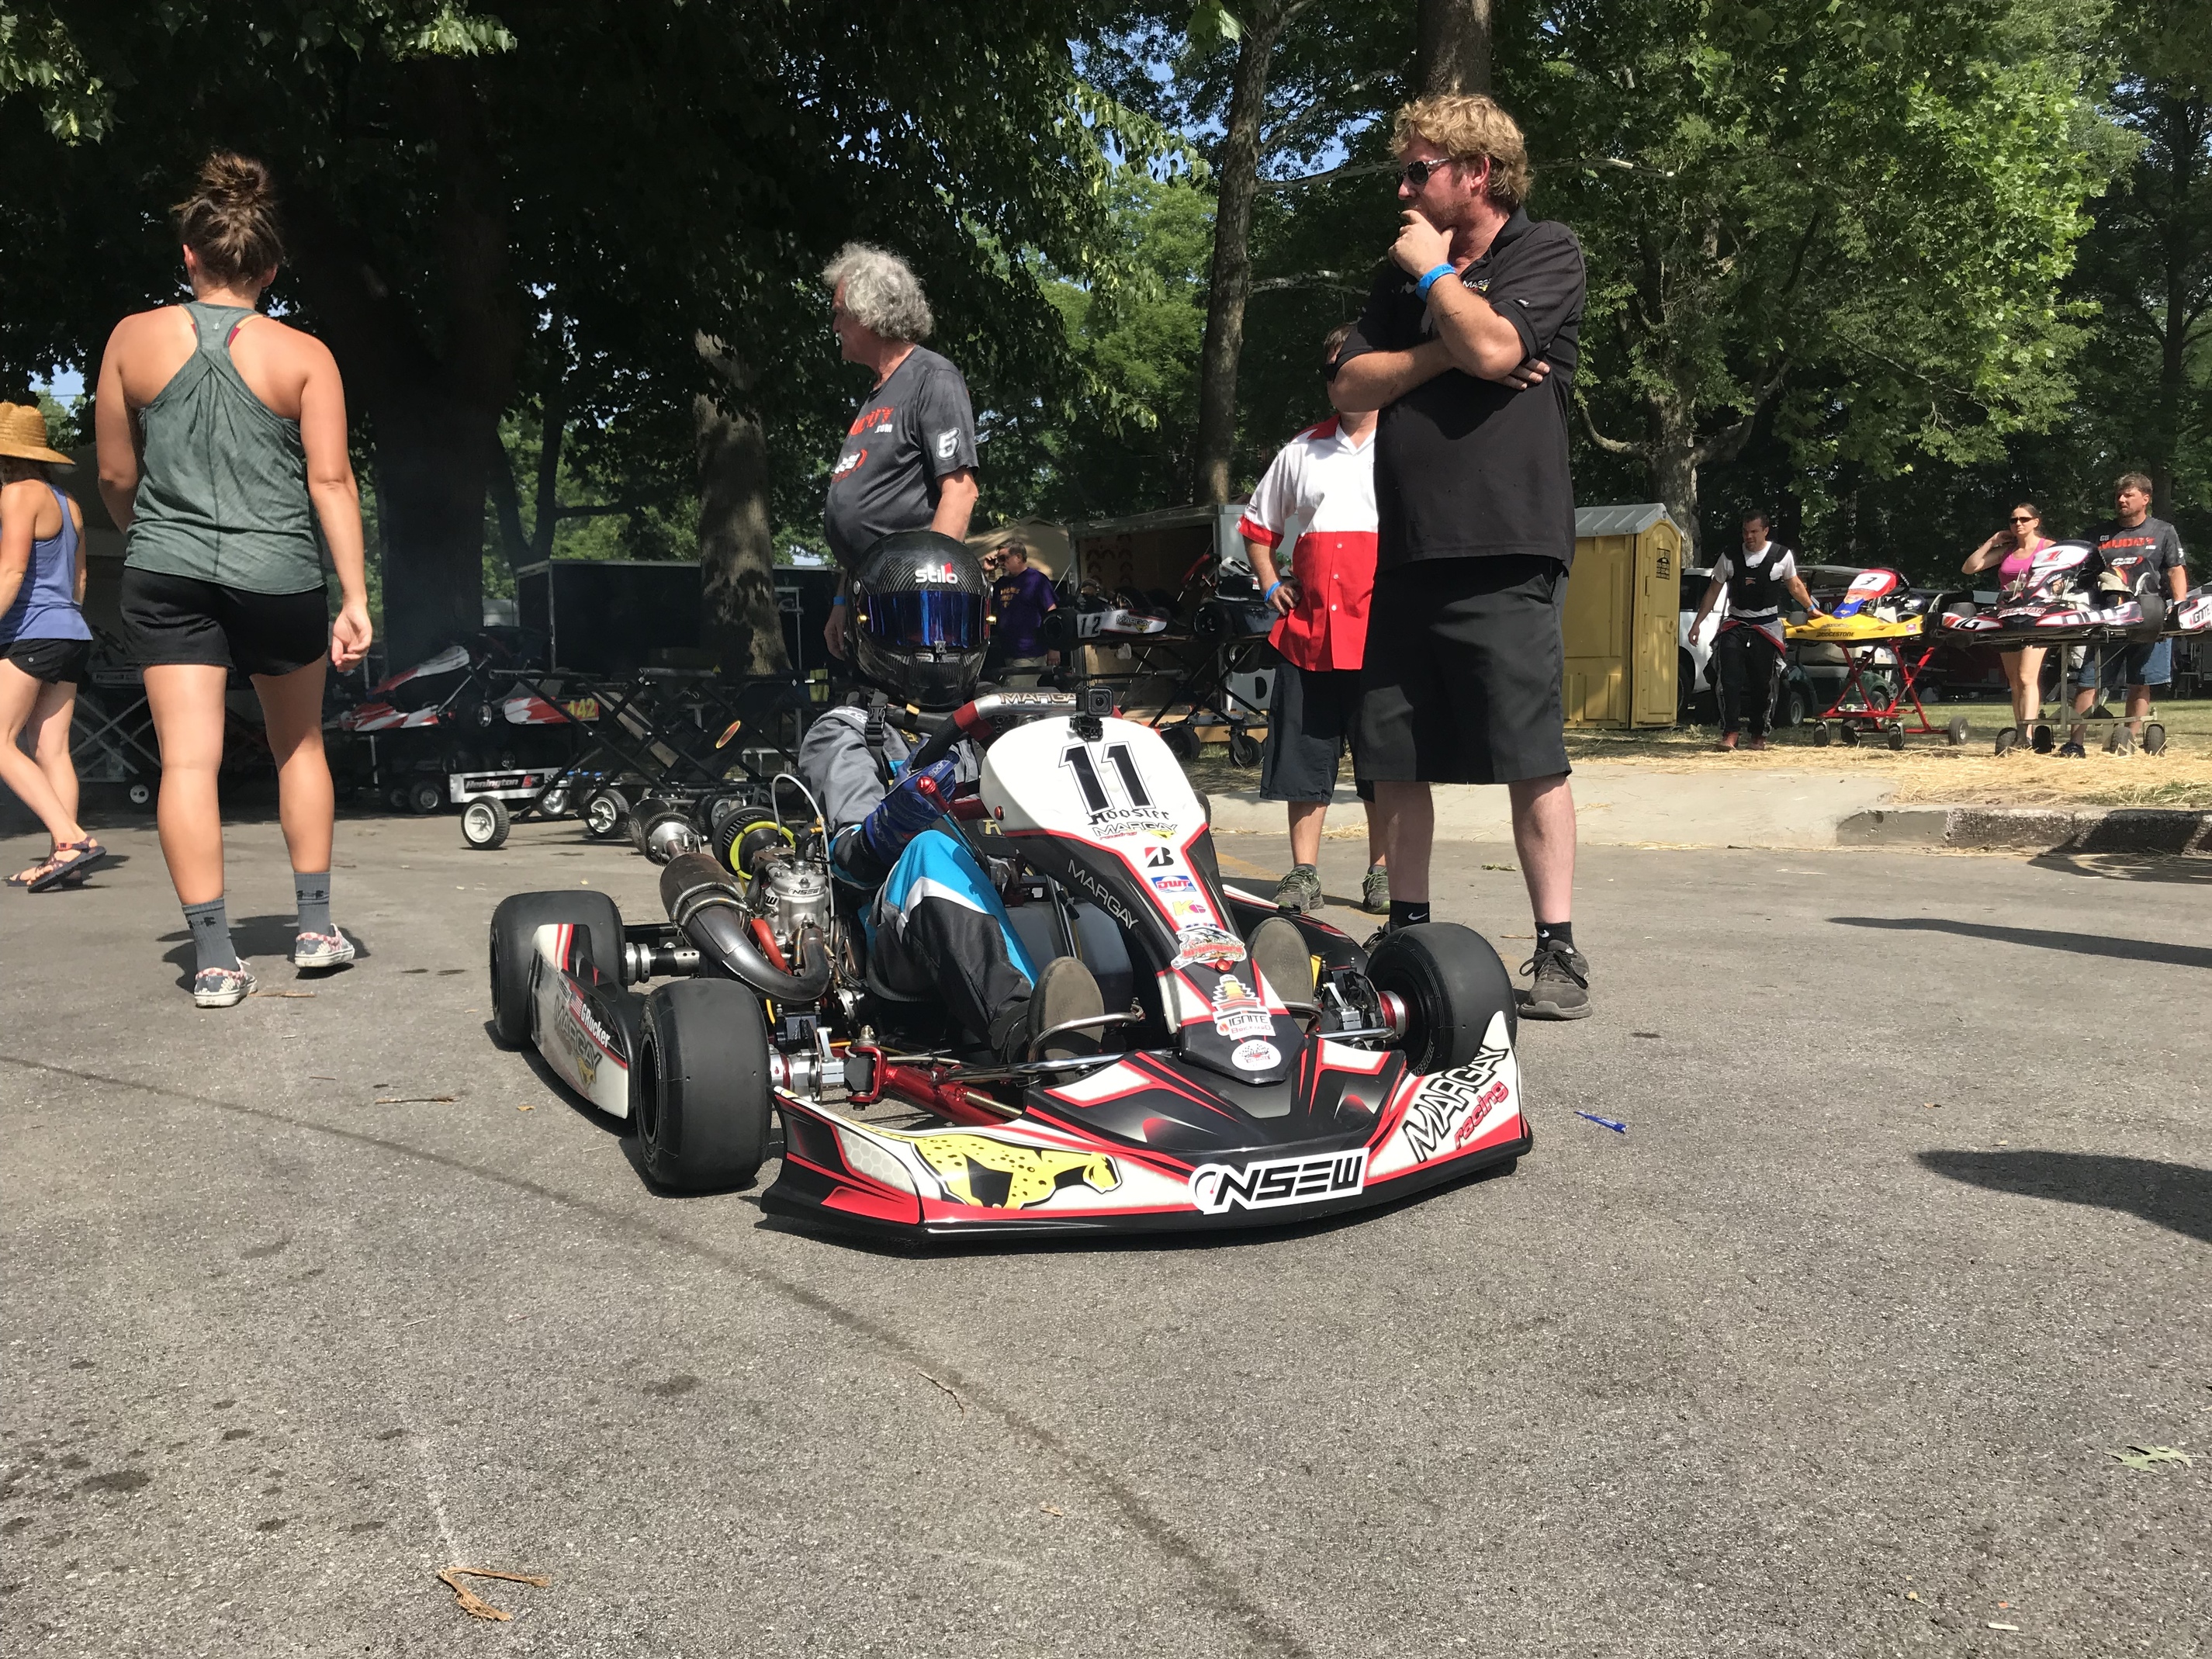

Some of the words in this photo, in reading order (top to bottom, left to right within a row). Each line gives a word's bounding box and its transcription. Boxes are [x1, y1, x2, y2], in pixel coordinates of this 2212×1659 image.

[936, 428, 961, 460] 5
[915, 562, 958, 584] stilo
[1860, 577, 1878, 586] 3
[998, 692, 1077, 705] MARGA
[1059, 741, 1156, 816] 11
[1092, 821, 1178, 838] MARGAY
[1068, 858, 1139, 930] MARGAY
[1156, 880, 1190, 890] DWT
[553, 994, 603, 1072] MARGAY
[580, 1003, 611, 1048] GRucker
[1228, 1015, 1269, 1027] IGNITE
[1401, 1044, 1510, 1164] MARGAY
[1453, 1080, 1509, 1151] racing
[1213, 1155, 1364, 1207] NSEW
